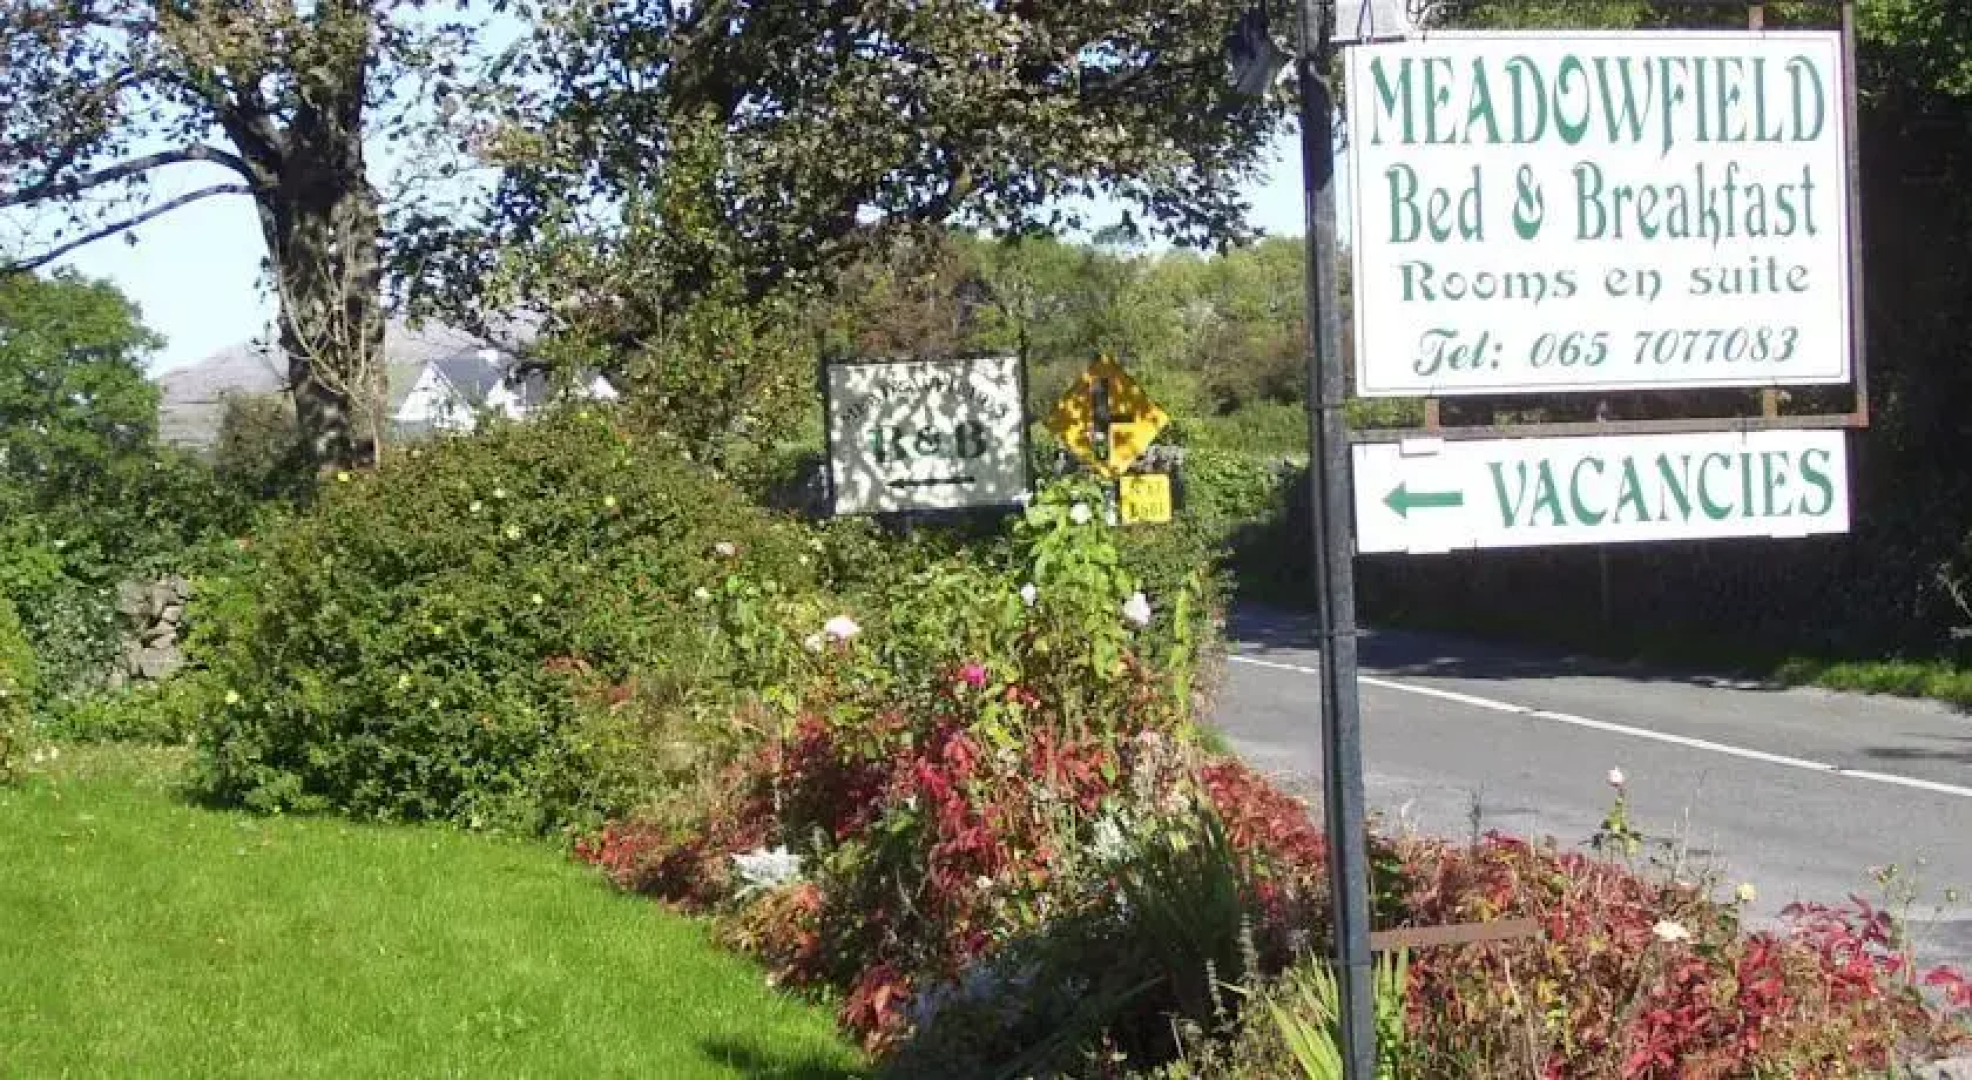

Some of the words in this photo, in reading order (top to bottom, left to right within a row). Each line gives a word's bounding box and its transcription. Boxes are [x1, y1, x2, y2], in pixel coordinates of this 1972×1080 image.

[1370, 53, 1826, 156] MEADOWFIELD
[1386, 162, 1484, 243] Bed
[1511, 164, 1545, 241] &
[1573, 160, 1818, 248] Breakfast
[1401, 260, 1577, 304] Rooms
[1604, 268, 1661, 303] en
[1689, 255, 1809, 297] suite
[1413, 328, 1503, 377] Tel:
[1530, 331, 1608, 368] 065
[1634, 327, 1799, 366] 7077083
[1489, 448, 1834, 529] VACANCIES
